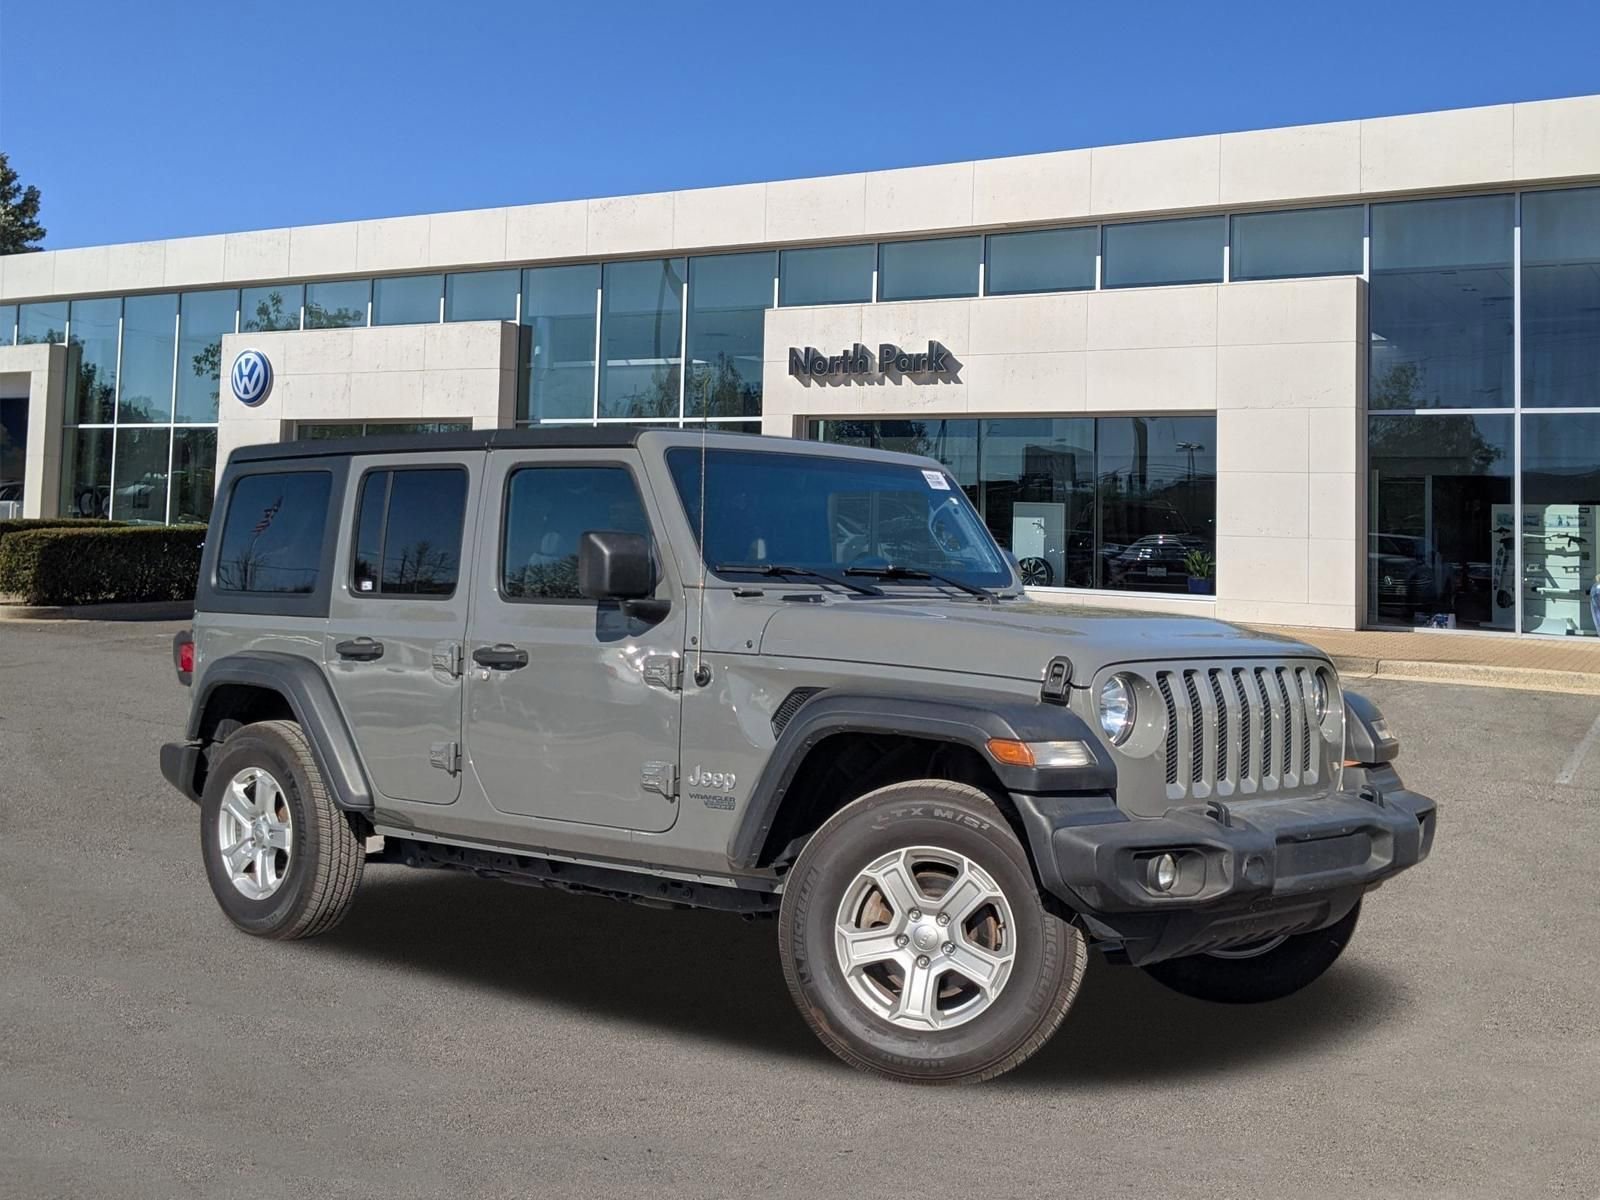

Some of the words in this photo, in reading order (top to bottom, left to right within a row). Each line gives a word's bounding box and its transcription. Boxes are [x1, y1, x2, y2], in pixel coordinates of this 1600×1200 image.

[788, 342, 872, 376] North
[878, 339, 949, 374] Park
[687, 764, 736, 793] Jeep
